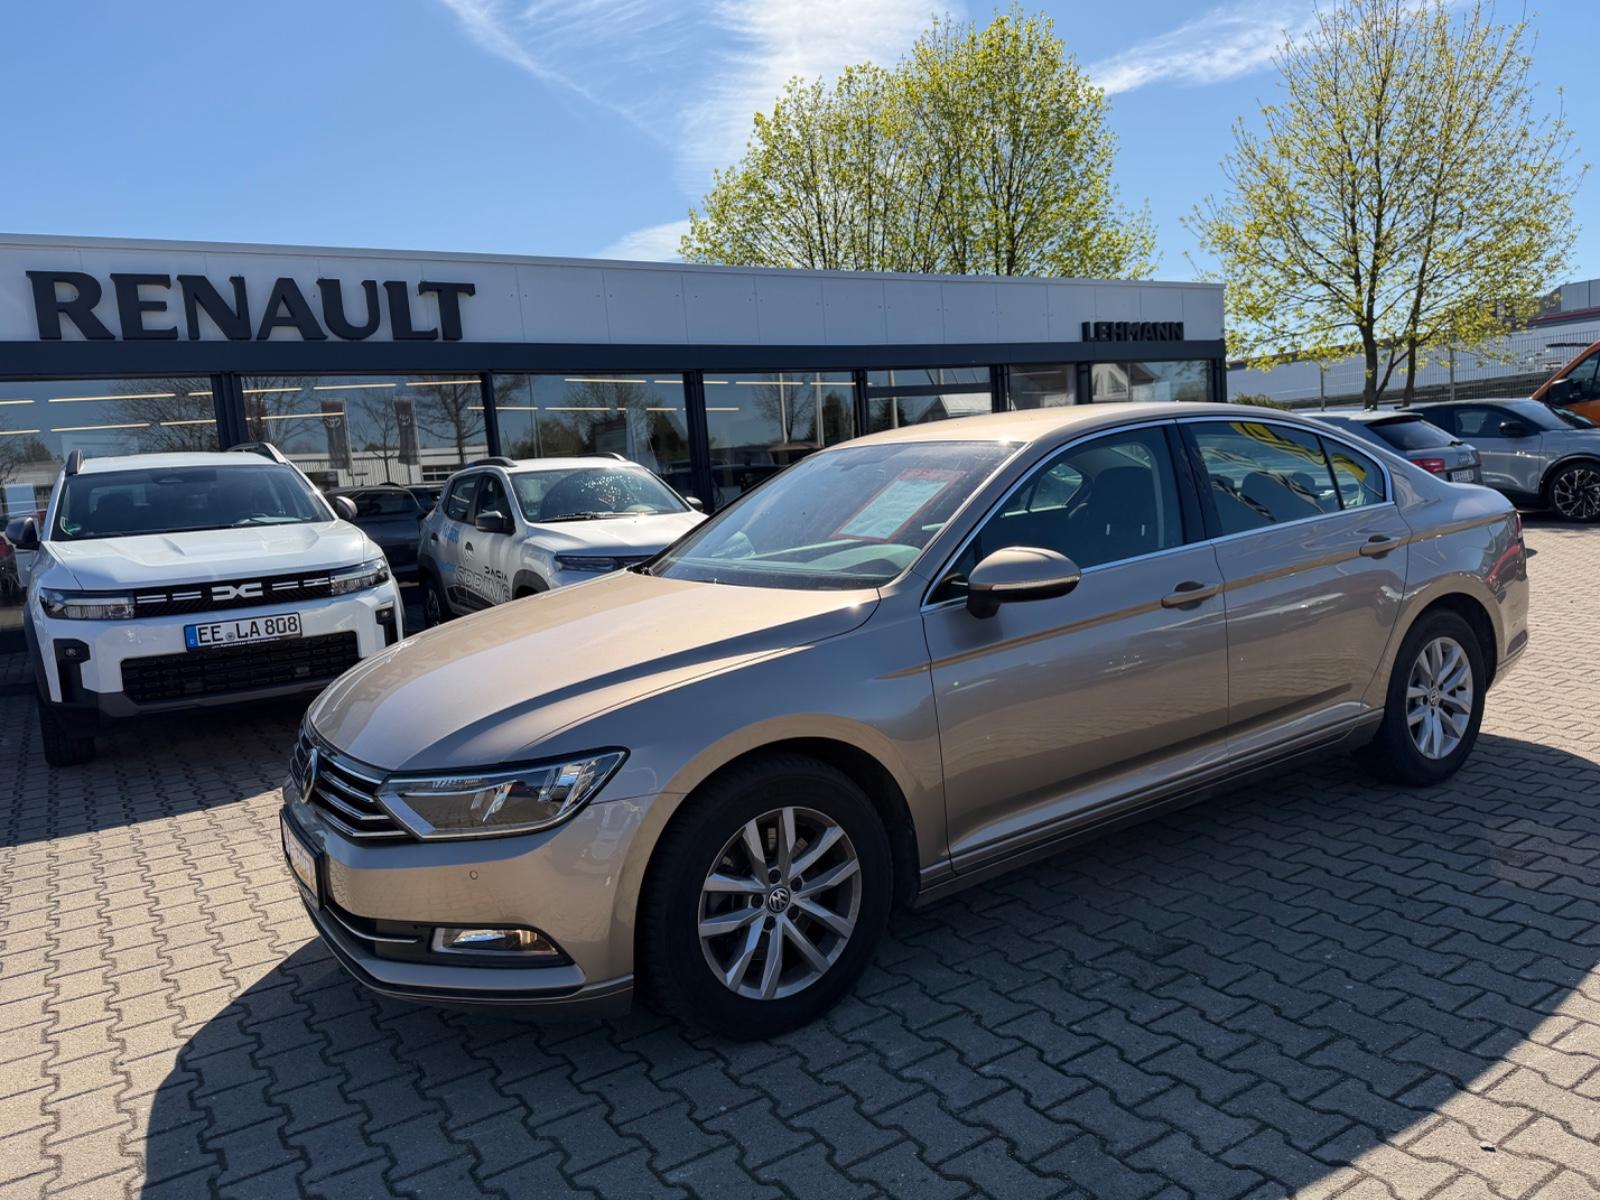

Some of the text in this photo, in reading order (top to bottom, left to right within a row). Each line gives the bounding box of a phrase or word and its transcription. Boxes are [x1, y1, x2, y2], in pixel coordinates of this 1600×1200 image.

[26, 271, 476, 341] RENAULT
[1081, 321, 1185, 342] LEHMANN
[484, 566, 509, 583] DACIA
[199, 626, 223, 644] EE
[236, 620, 260, 639] LA
[265, 616, 298, 635] 808
